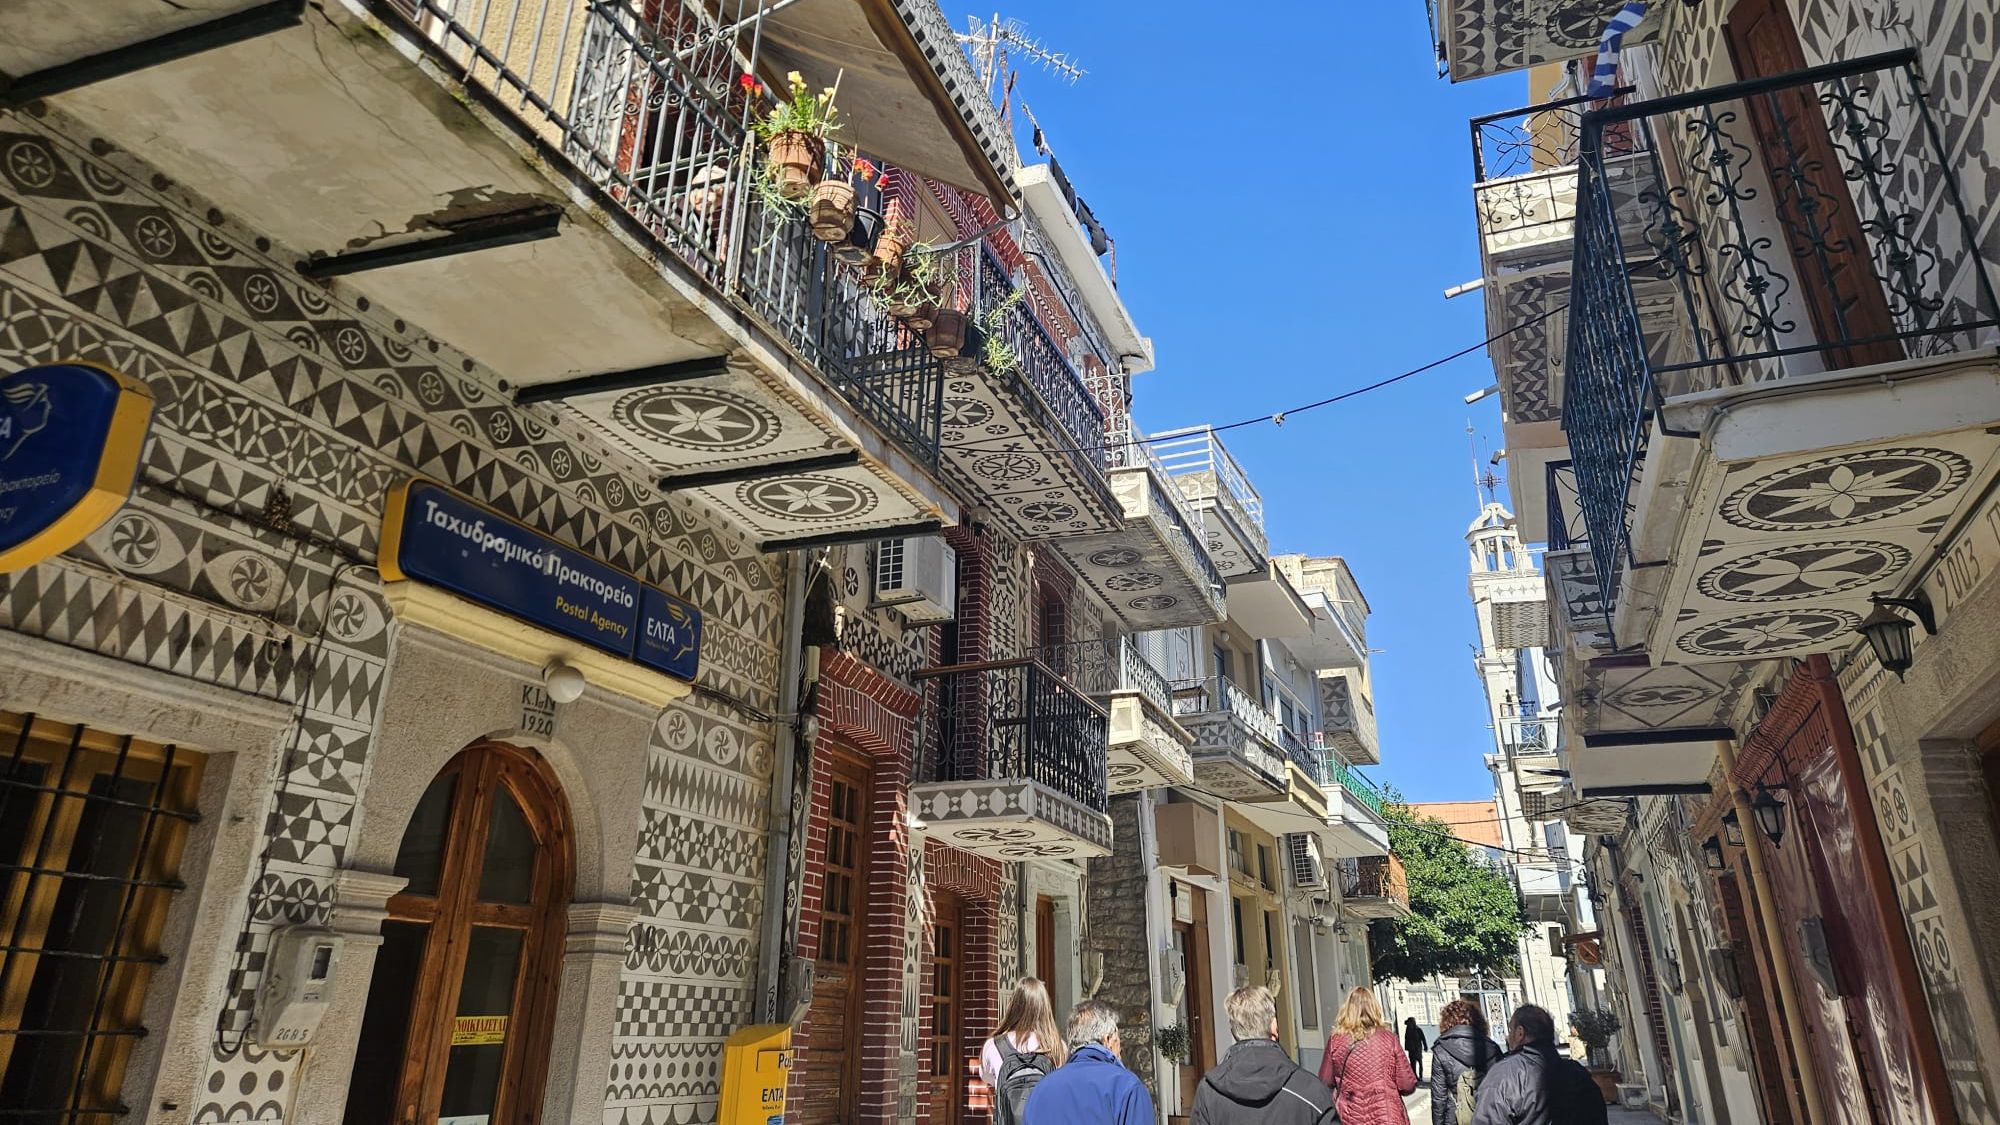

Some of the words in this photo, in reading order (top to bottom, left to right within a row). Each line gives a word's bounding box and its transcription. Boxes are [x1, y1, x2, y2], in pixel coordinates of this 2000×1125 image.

[425, 500, 543, 569] Ταχυδρομικό
[548, 553, 633, 608] Πρακτορείο
[556, 596, 588, 620] Postal
[590, 610, 628, 640] Agency
[646, 617, 675, 645] ΕΛΤΑ
[521, 713, 553, 736] 1920
[455, 1018, 507, 1032] ΝΟΙΚΙΑΖΕΤΑΙ
[761, 1088, 784, 1102] ΕΛΤΑ
